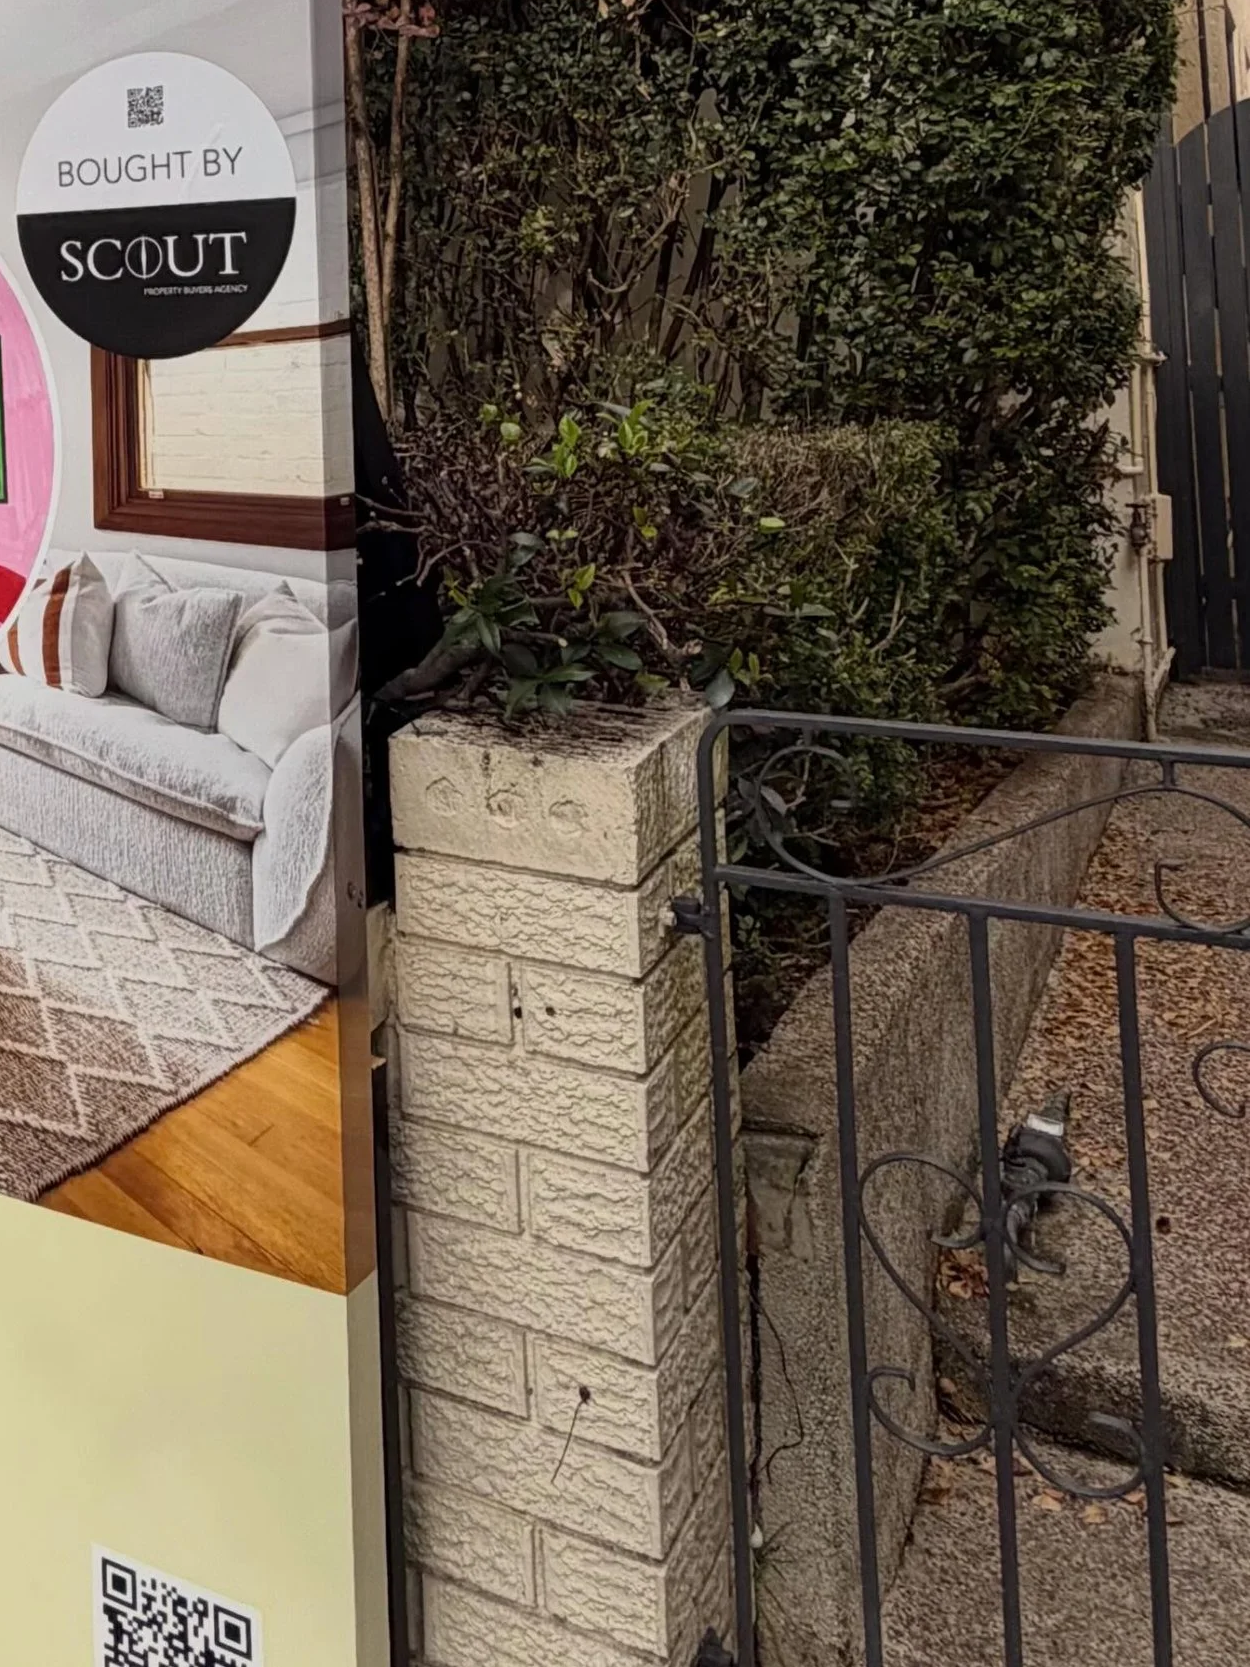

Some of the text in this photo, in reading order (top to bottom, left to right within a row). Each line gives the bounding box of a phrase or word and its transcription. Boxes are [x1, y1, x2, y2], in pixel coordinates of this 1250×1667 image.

[57, 146, 243, 188] BOUGHT BY
[60, 231, 248, 282] SCOUT
